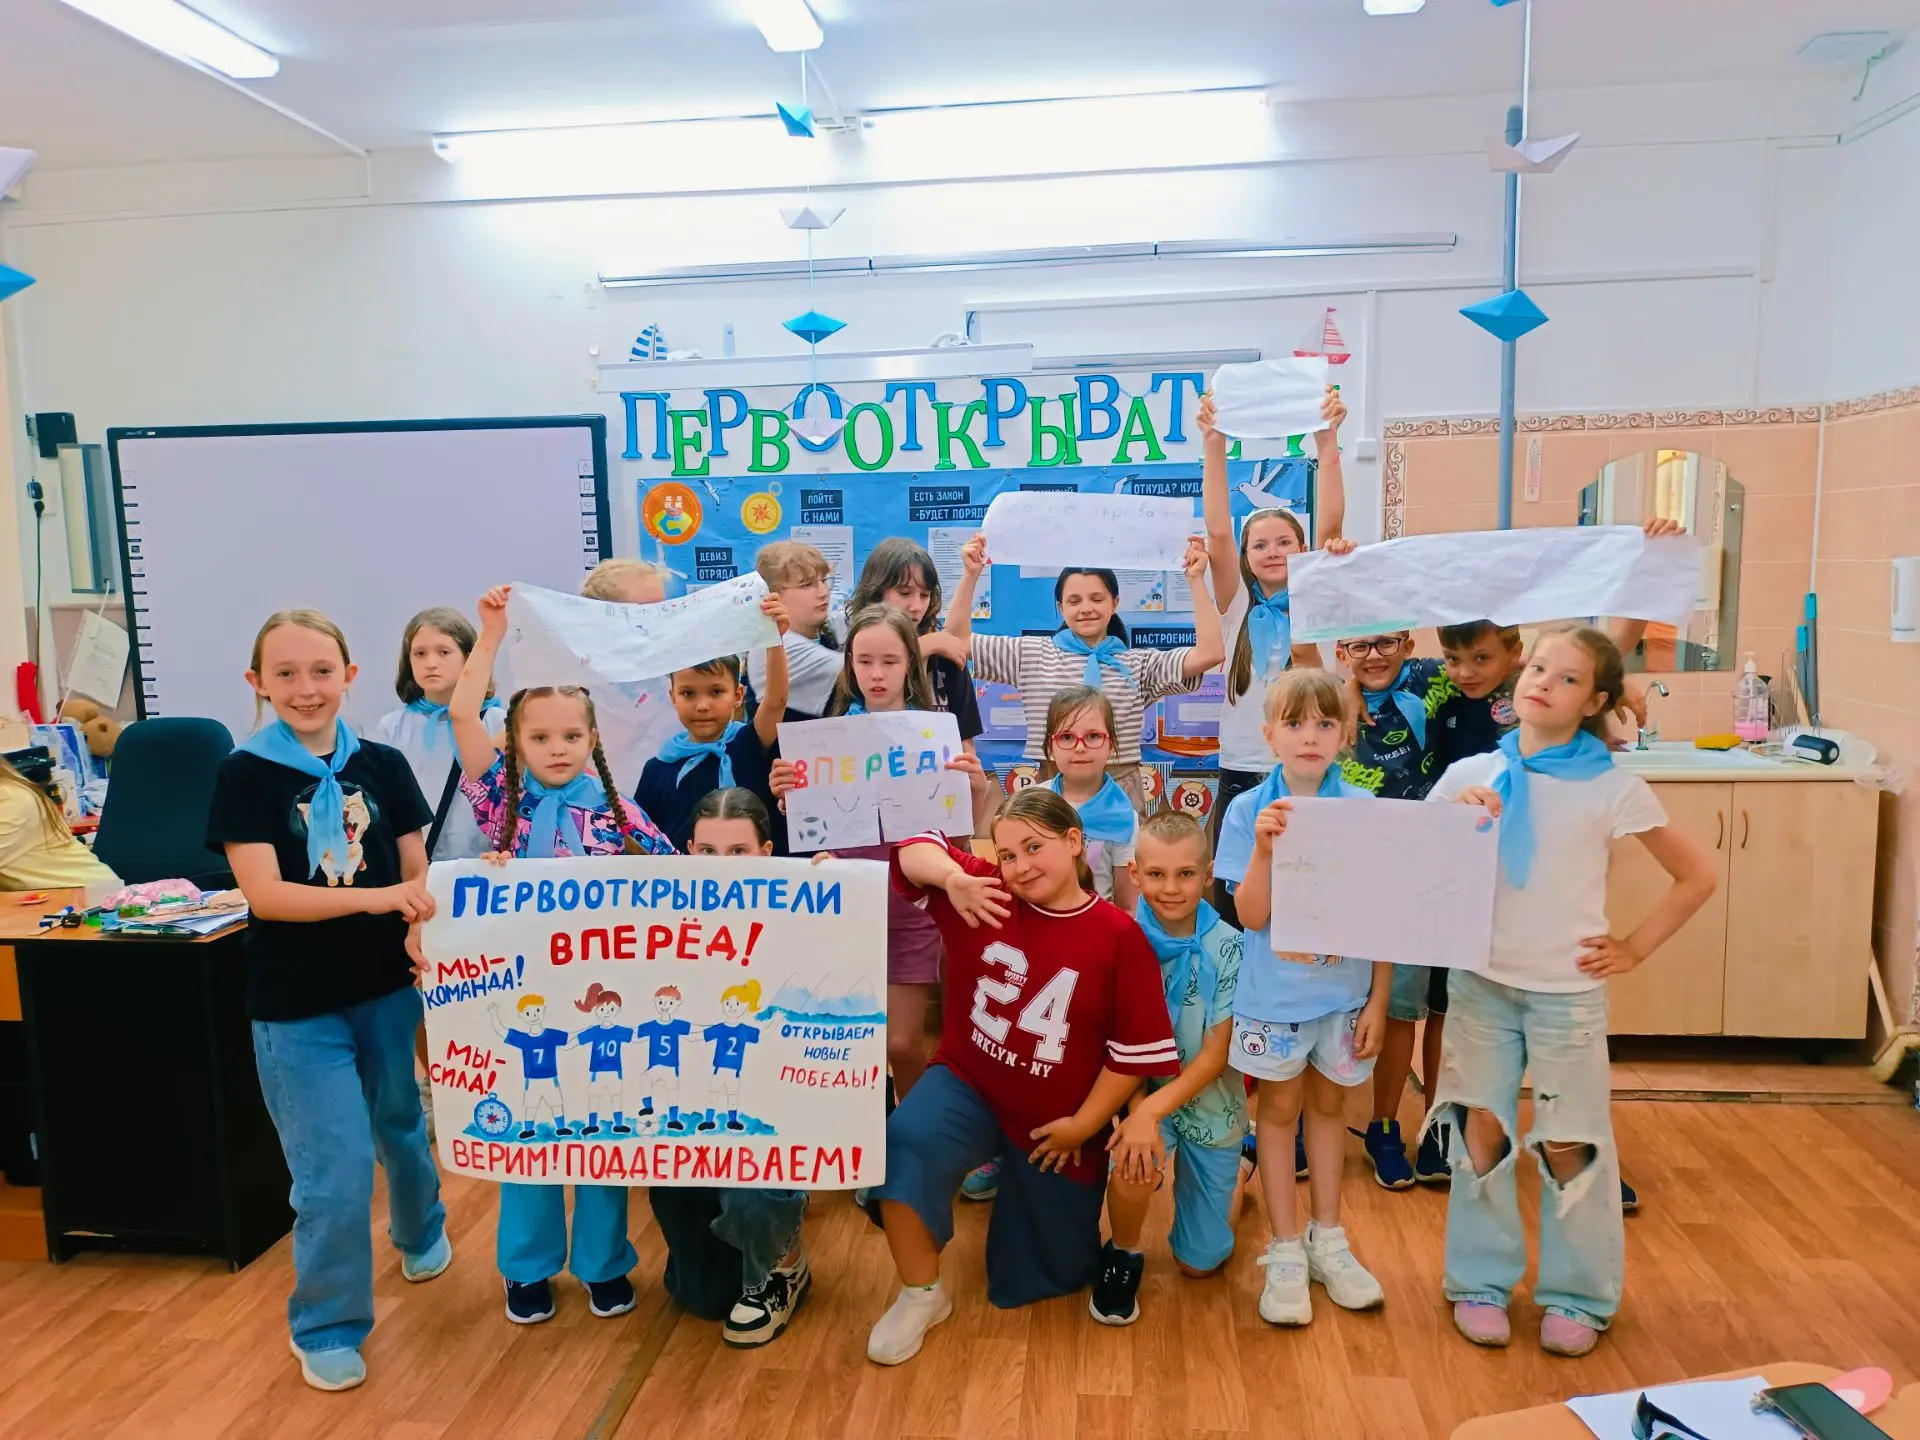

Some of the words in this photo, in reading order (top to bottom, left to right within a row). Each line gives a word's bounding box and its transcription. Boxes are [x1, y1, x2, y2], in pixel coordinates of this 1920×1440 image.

[620, 371, 1342, 476] ПЕРВООТКРЫВАТ
[808, 493, 834, 504] ПОЙТЕ
[914, 491, 934, 502] ЕСТЬ
[936, 490, 964, 501] ЗАКОН
[1134, 483, 1177, 494] ОТКУДА?
[803, 511, 809, 523] С
[812, 511, 840, 523] НАМИ
[700, 551, 727, 562] ДЕВИЗ
[699, 568, 734, 580] ОТРЯДА
[1135, 632, 1197, 645] НАСТРОЕНИЕ
[794, 744, 950, 788] ВПЕРЁД!
[452, 874, 842, 918] ПЕРВООТКРЫВАТЕЛИ
[550, 917, 764, 967] ВПЕРЁД!
[424, 955, 525, 1010] КОМАНДА!
[969, 940, 1080, 1064] 24
[781, 1024, 875, 1041] ОТКРЫВАЕМ
[597, 1039, 618, 1058] 10
[658, 1035, 672, 1057] 5
[725, 1036, 738, 1056] 2
[804, 1046, 851, 1061] НОВЫЕ
[971, 1026, 1019, 1068] BRKLYN
[1029, 1060, 1053, 1078] NY
[533, 1048, 545, 1065] 7
[430, 1063, 497, 1095] СИЛА!
[780, 1064, 879, 1090] ПОБЕДЫ!
[452, 1139, 560, 1177] ВЕРИМ!
[566, 1143, 863, 1184] ПОДДЕРЖИВАЕМ!
